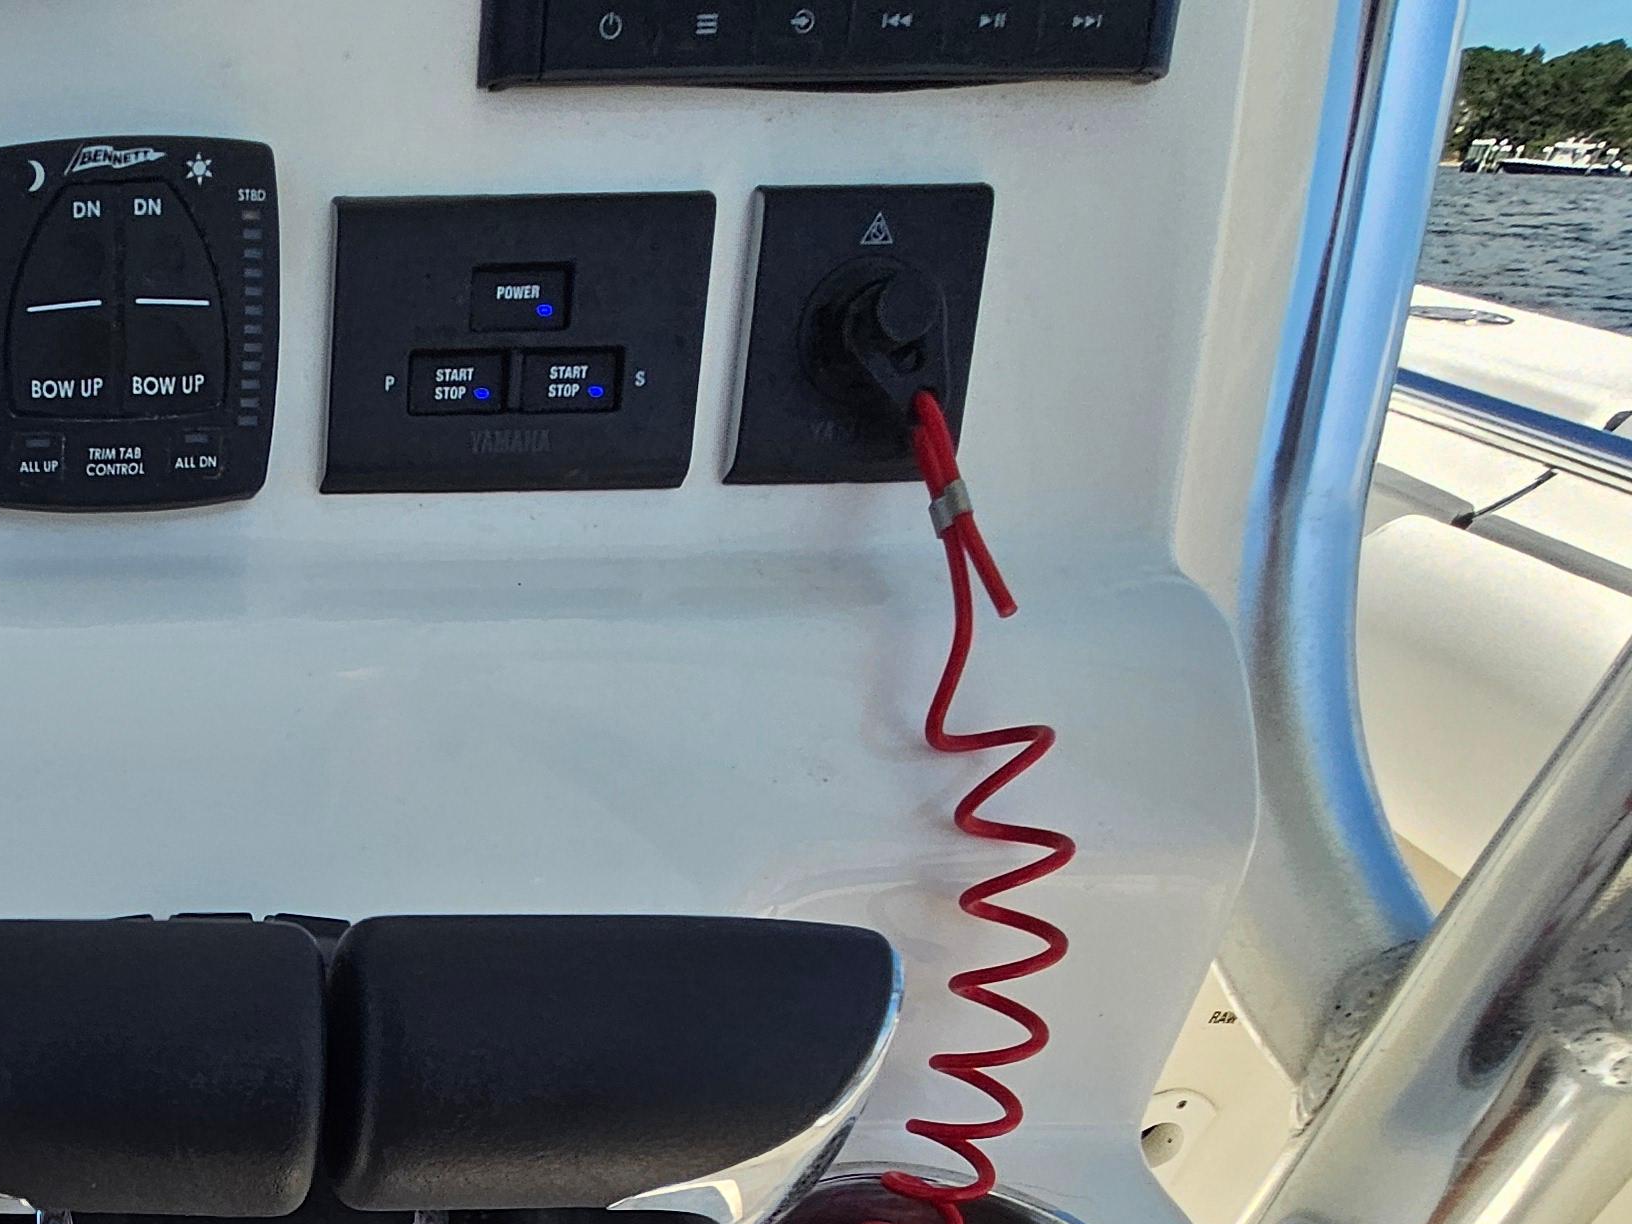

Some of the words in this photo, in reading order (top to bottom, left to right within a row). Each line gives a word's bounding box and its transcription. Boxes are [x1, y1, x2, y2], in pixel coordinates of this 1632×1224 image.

[80, 148, 151, 167] BENNETT
[238, 188, 267, 202] STBD
[73, 201, 101, 218] DN
[134, 198, 162, 216] DN
[496, 285, 540, 300] POWER
[435, 367, 474, 382] START
[549, 365, 588, 380] START
[634, 370, 646, 387] S
[31, 379, 74, 399] BOW
[81, 377, 104, 398] UP
[132, 374, 177, 396] BOW
[182, 374, 205, 394] UP
[384, 375, 395, 392] P
[548, 383, 580, 398] STOP
[434, 385, 467, 400] STOP
[88, 447, 116, 461] TRIM
[119, 447, 142, 460] TAB
[20, 461, 41, 473] ALL
[43, 460, 59, 473] UP
[86, 462, 145, 477] CONTROL
[174, 456, 196, 470] ALL
[199, 455, 218, 469] DN
